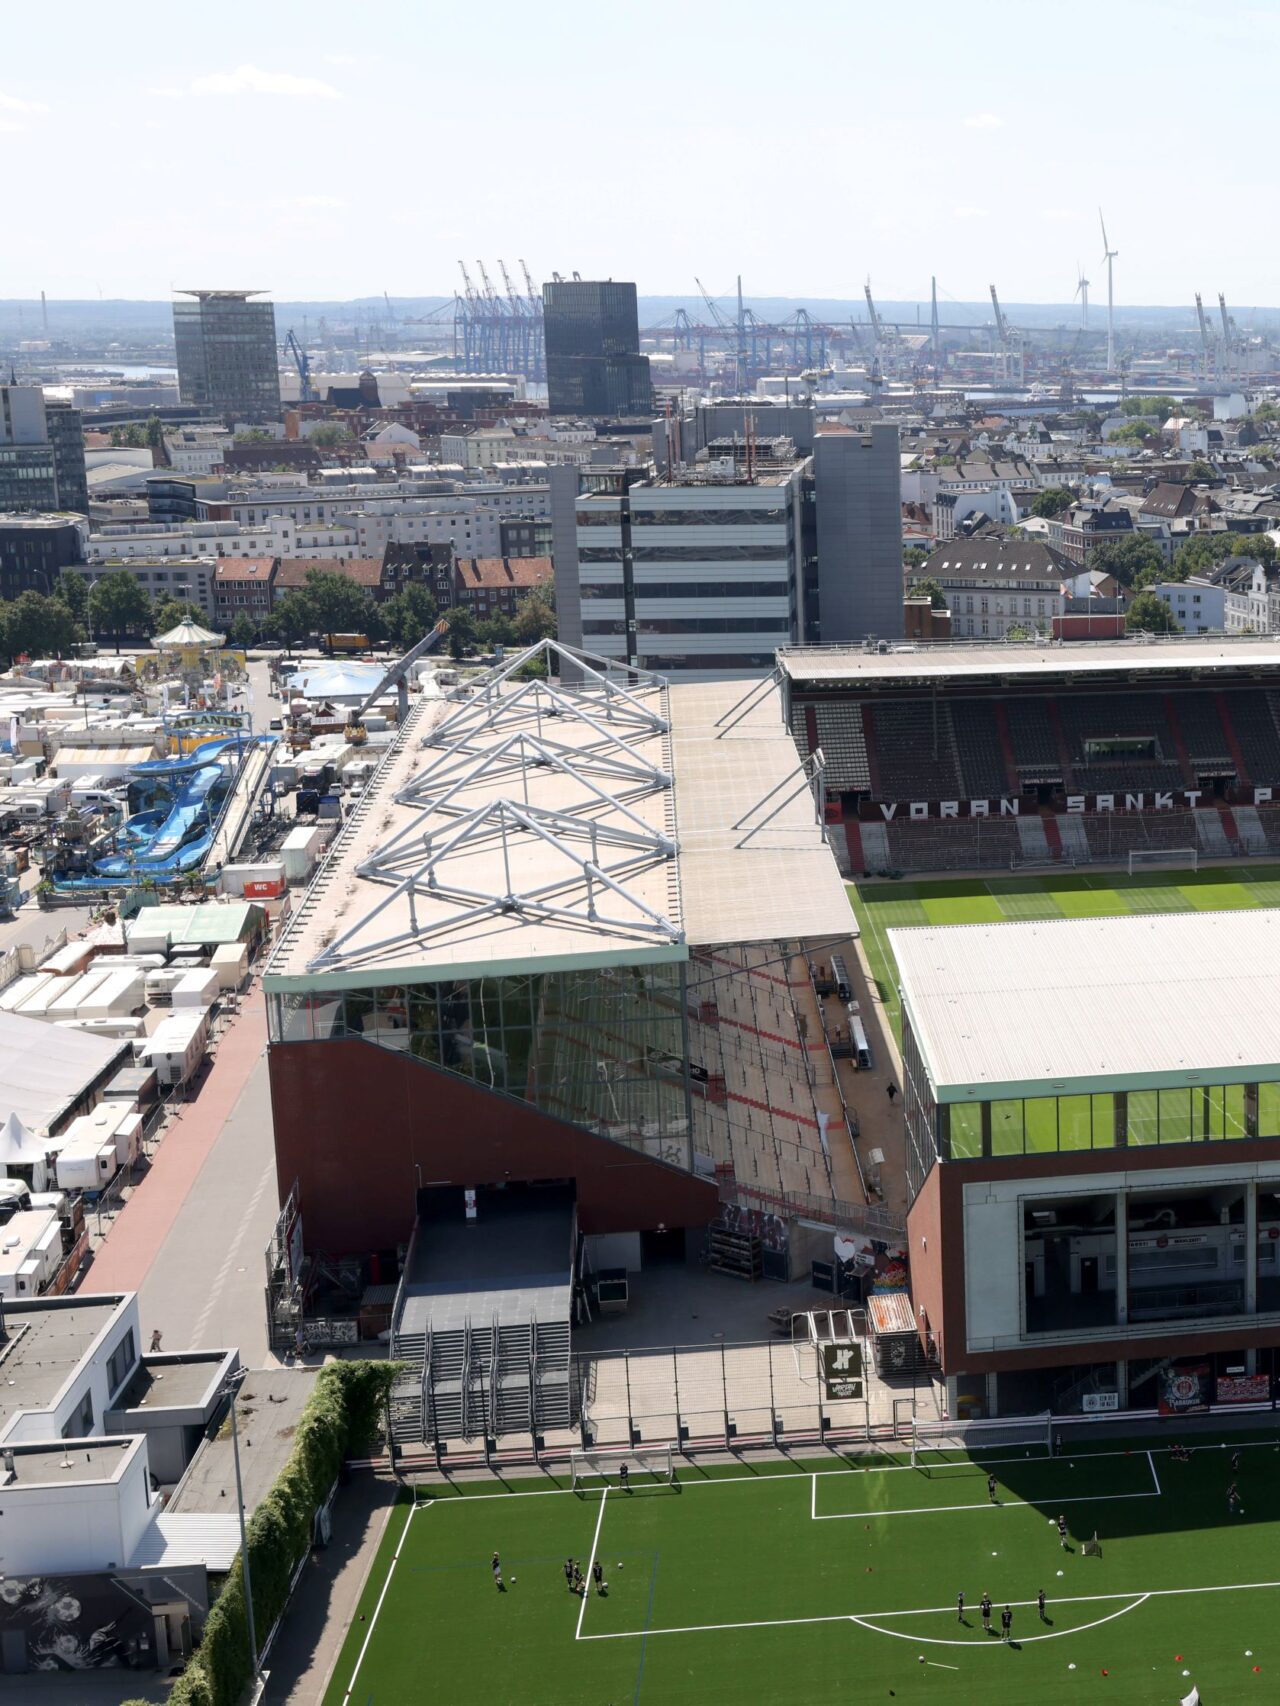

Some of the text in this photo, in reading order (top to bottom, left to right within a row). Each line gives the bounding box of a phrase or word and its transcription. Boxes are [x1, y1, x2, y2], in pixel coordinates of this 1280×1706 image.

[173, 715, 243, 729] ATLANTIS
[880, 798, 1020, 821] VORAN
[1066, 790, 1203, 812] SANKT
[254, 883, 268, 891] WC
